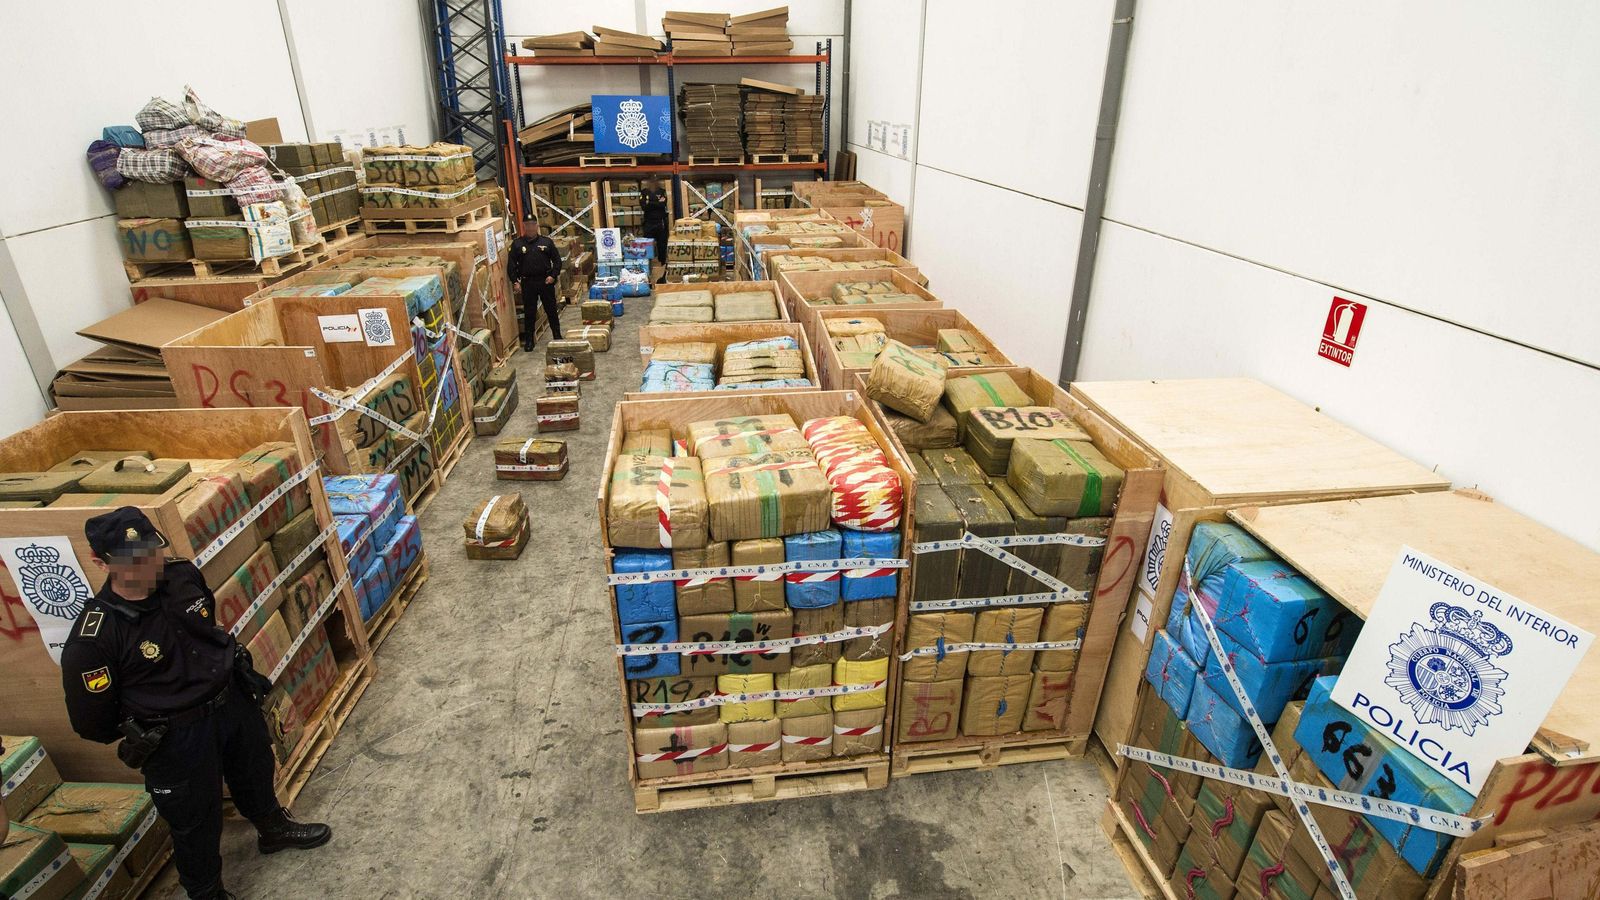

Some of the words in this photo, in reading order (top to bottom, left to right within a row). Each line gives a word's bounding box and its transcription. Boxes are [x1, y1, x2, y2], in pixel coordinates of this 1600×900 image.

[1319, 342, 1353, 364] EXTINTOR
[1402, 554, 1475, 597] MINISTERIO
[1476, 590, 1503, 613] DEL
[1505, 604, 1579, 649] INTERIOR
[1411, 647, 1440, 662] CUERPO
[1445, 649, 1479, 683] NACIONAL
[1419, 688, 1450, 709] POLICIA
[1351, 692, 1472, 786] POLICIA
[19, 758, 38, 777] C.N.P.
[1232, 678, 1246, 704] C.N.P.
[1256, 724, 1273, 751] C.N.P.
[1310, 824, 1327, 853] C.N.P.
[1176, 760, 1190, 768] C.N.P.
[1201, 766, 1217, 775] C.N.P.
[1228, 772, 1246, 781] C.N.P.
[1259, 779, 1279, 789] C.N.P.
[1293, 786, 1315, 798] C.N.P.
[1333, 794, 1358, 806] C.N.P.
[1377, 803, 1406, 816] C.N.P.
[1430, 815, 1464, 831] C.N.P.
[25, 872, 49, 894] C.N.P.
